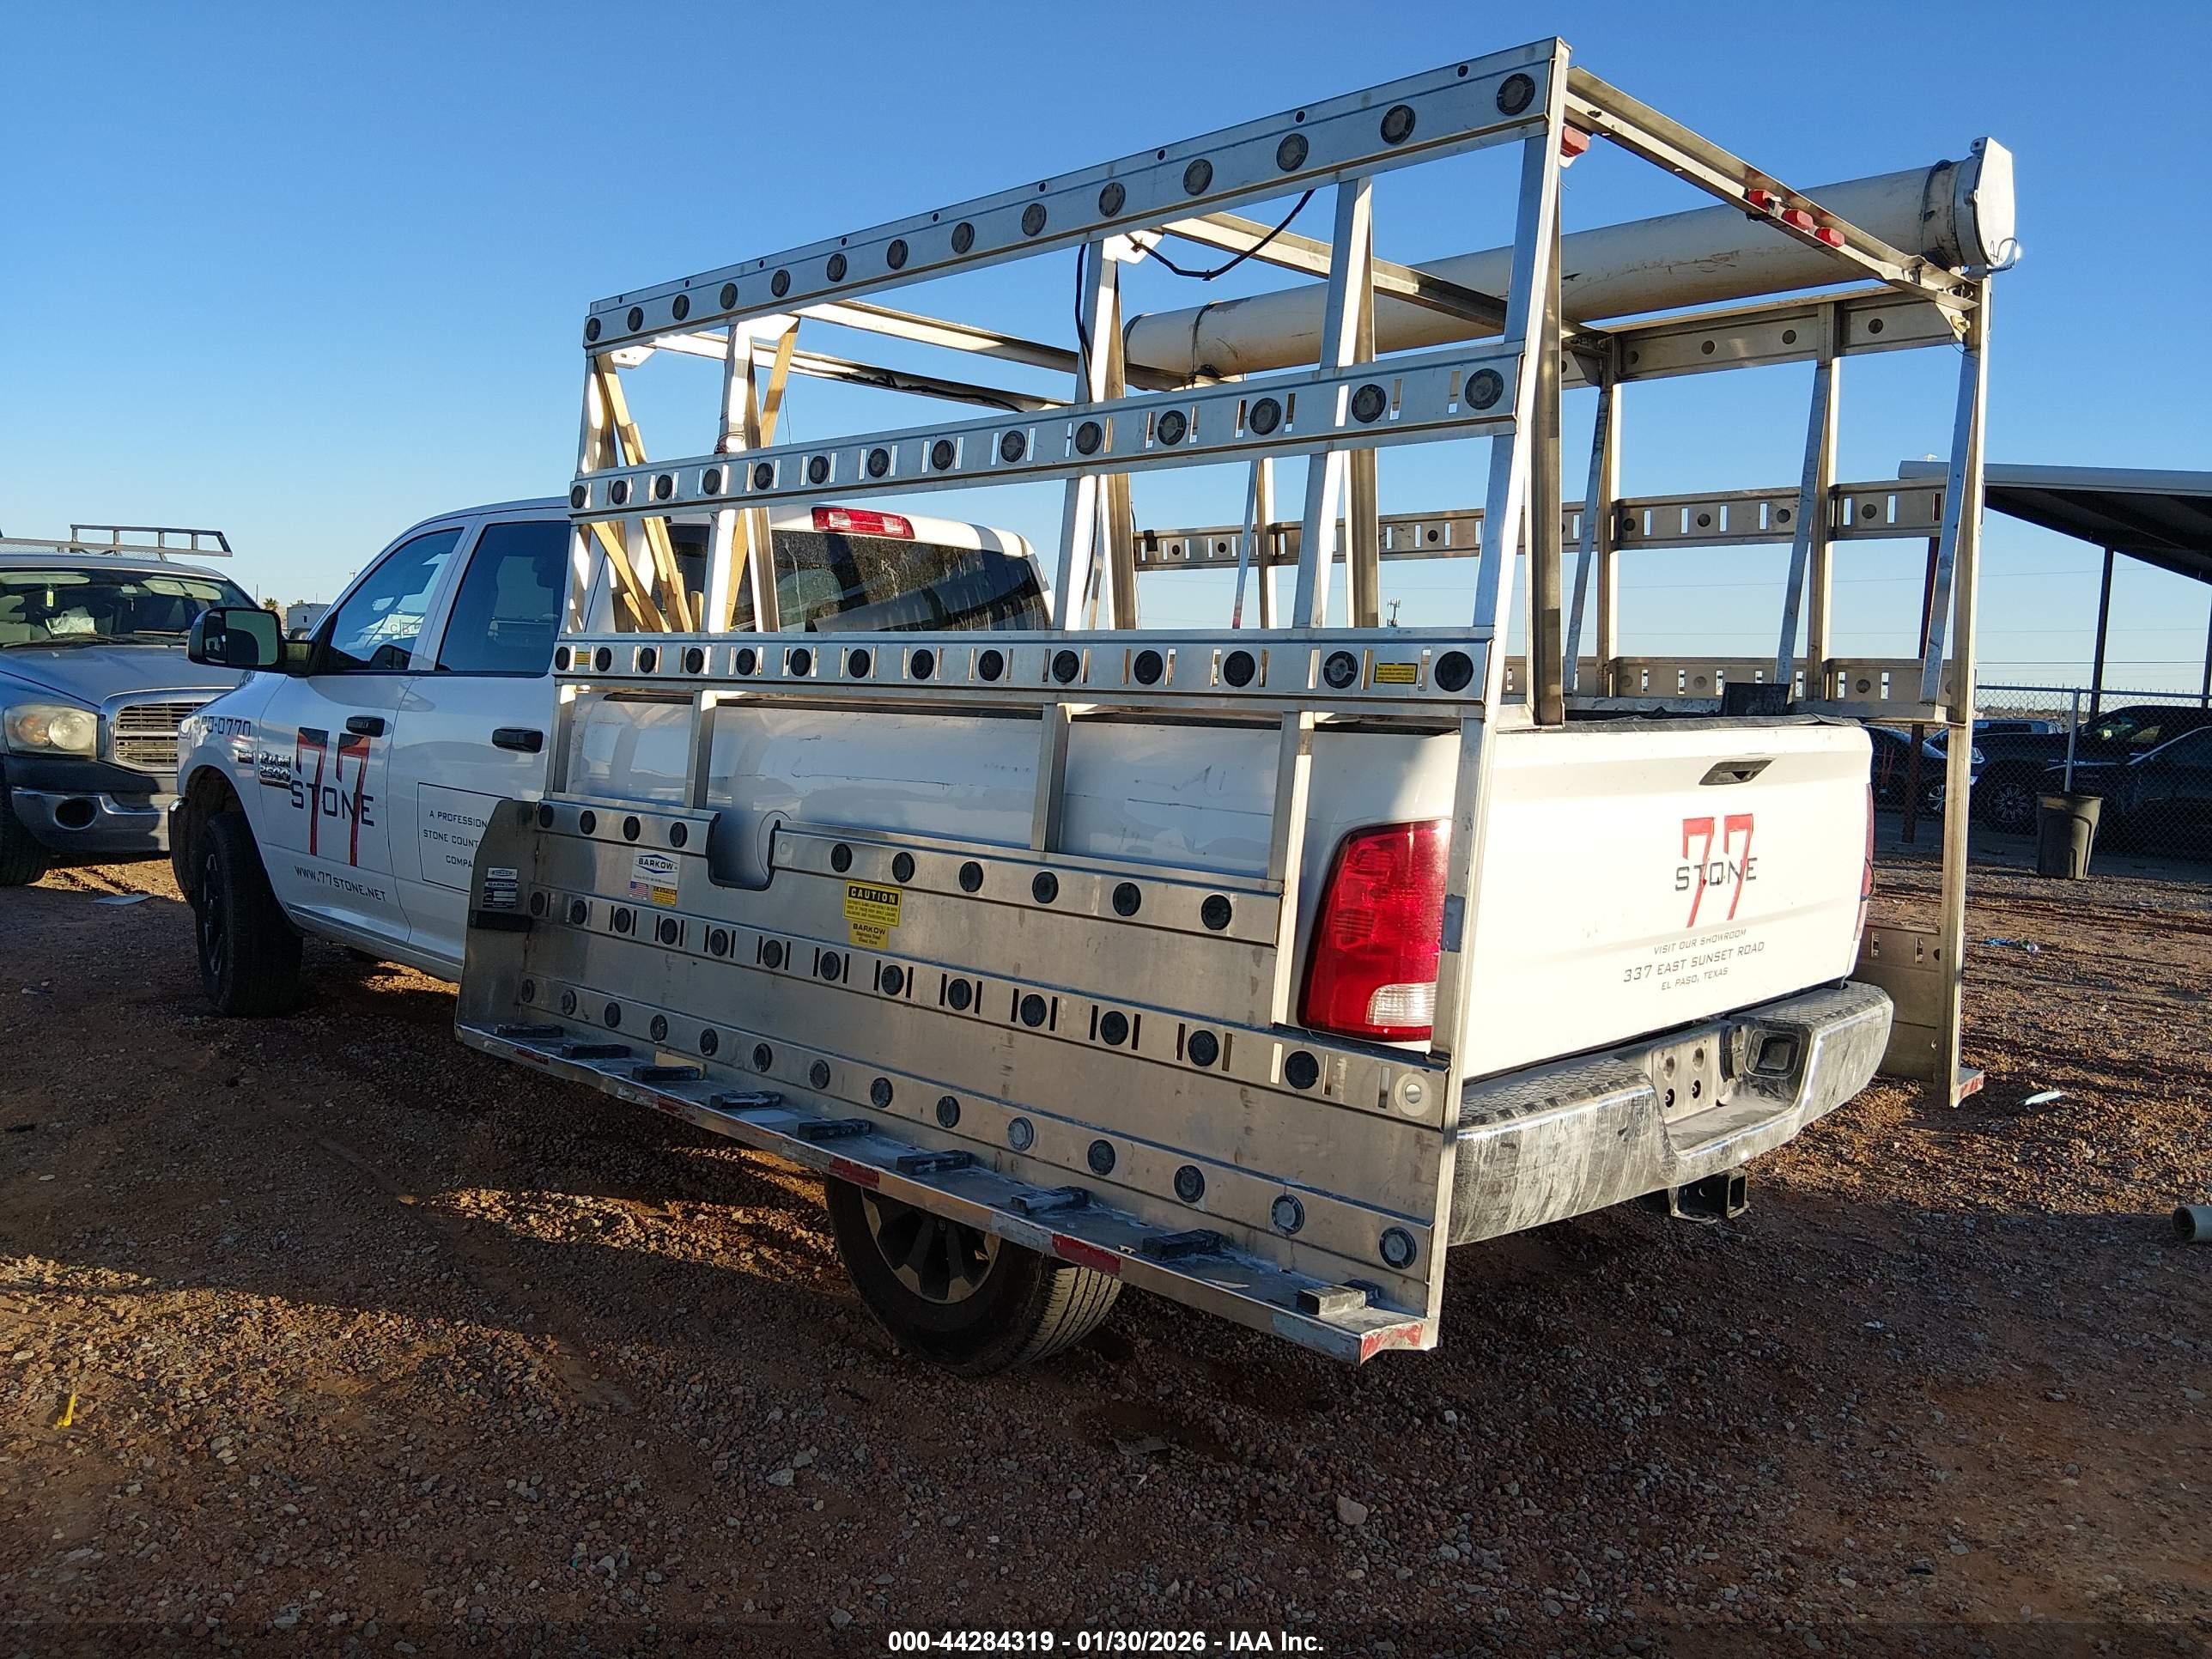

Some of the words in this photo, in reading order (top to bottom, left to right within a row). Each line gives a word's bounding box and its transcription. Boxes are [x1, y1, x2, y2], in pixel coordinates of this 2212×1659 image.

[291, 780, 374, 826] STONE
[296, 727, 371, 866] 77
[423, 830, 448, 842] STONE
[638, 858, 673, 870] BARKOW
[1675, 857, 1758, 891] STONE
[1683, 813, 1753, 927] 77
[294, 866, 386, 901] WWW.77STONE.NET
[851, 888, 896, 903] CAUTION
[853, 923, 886, 935] BARKOW
[1654, 944, 1677, 955] VISIT
[1679, 939, 1697, 950] OUR
[1700, 928, 1747, 945] SHOWROOM
[1623, 964, 1653, 982] 337
[1657, 959, 1687, 975] EAST
[1691, 949, 1734, 968] SUNSET
[1737, 941, 1765, 957] ROAD
[1662, 981, 1671, 990] EL
[1704, 967, 1729, 980] TEXAS
